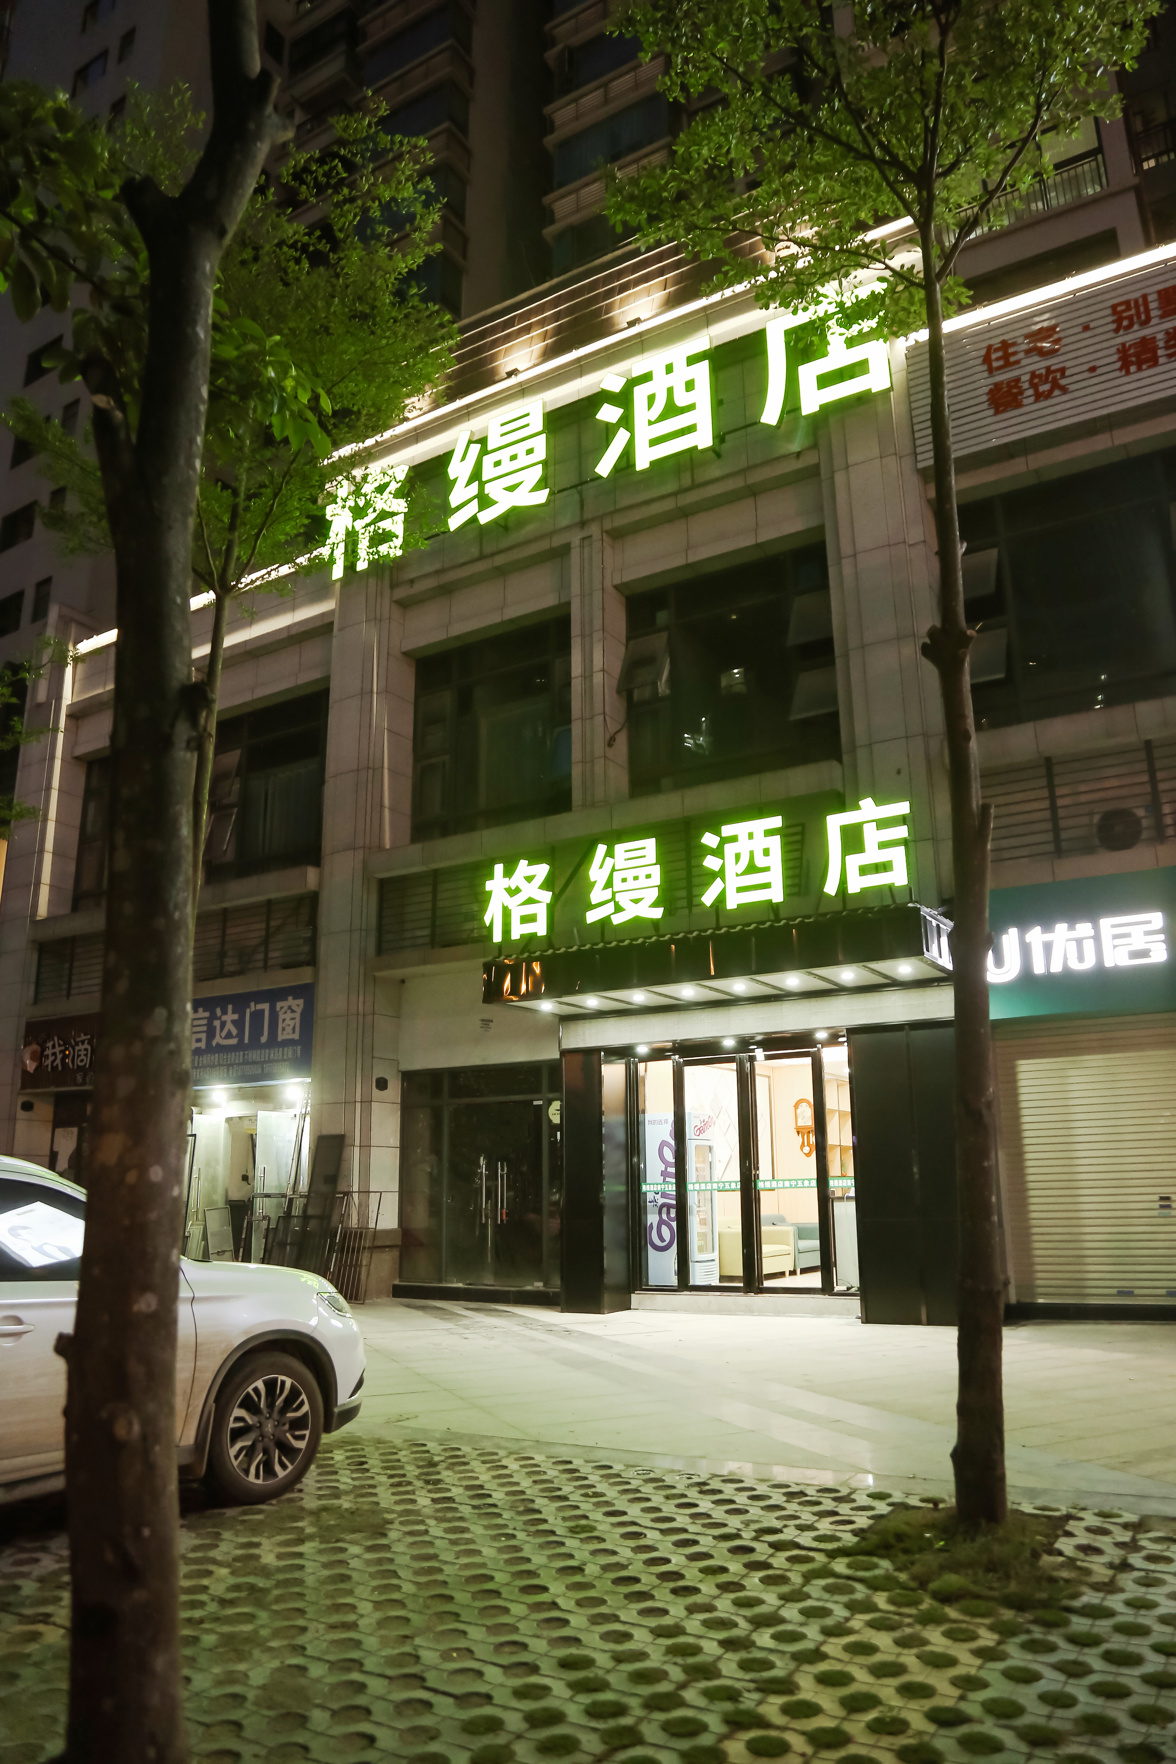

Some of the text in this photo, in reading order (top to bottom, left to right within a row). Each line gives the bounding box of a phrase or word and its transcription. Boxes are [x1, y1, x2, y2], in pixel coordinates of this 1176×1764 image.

[325, 281, 892, 580] 格缦酒店
[484, 797, 911, 943] 格缦酒店
